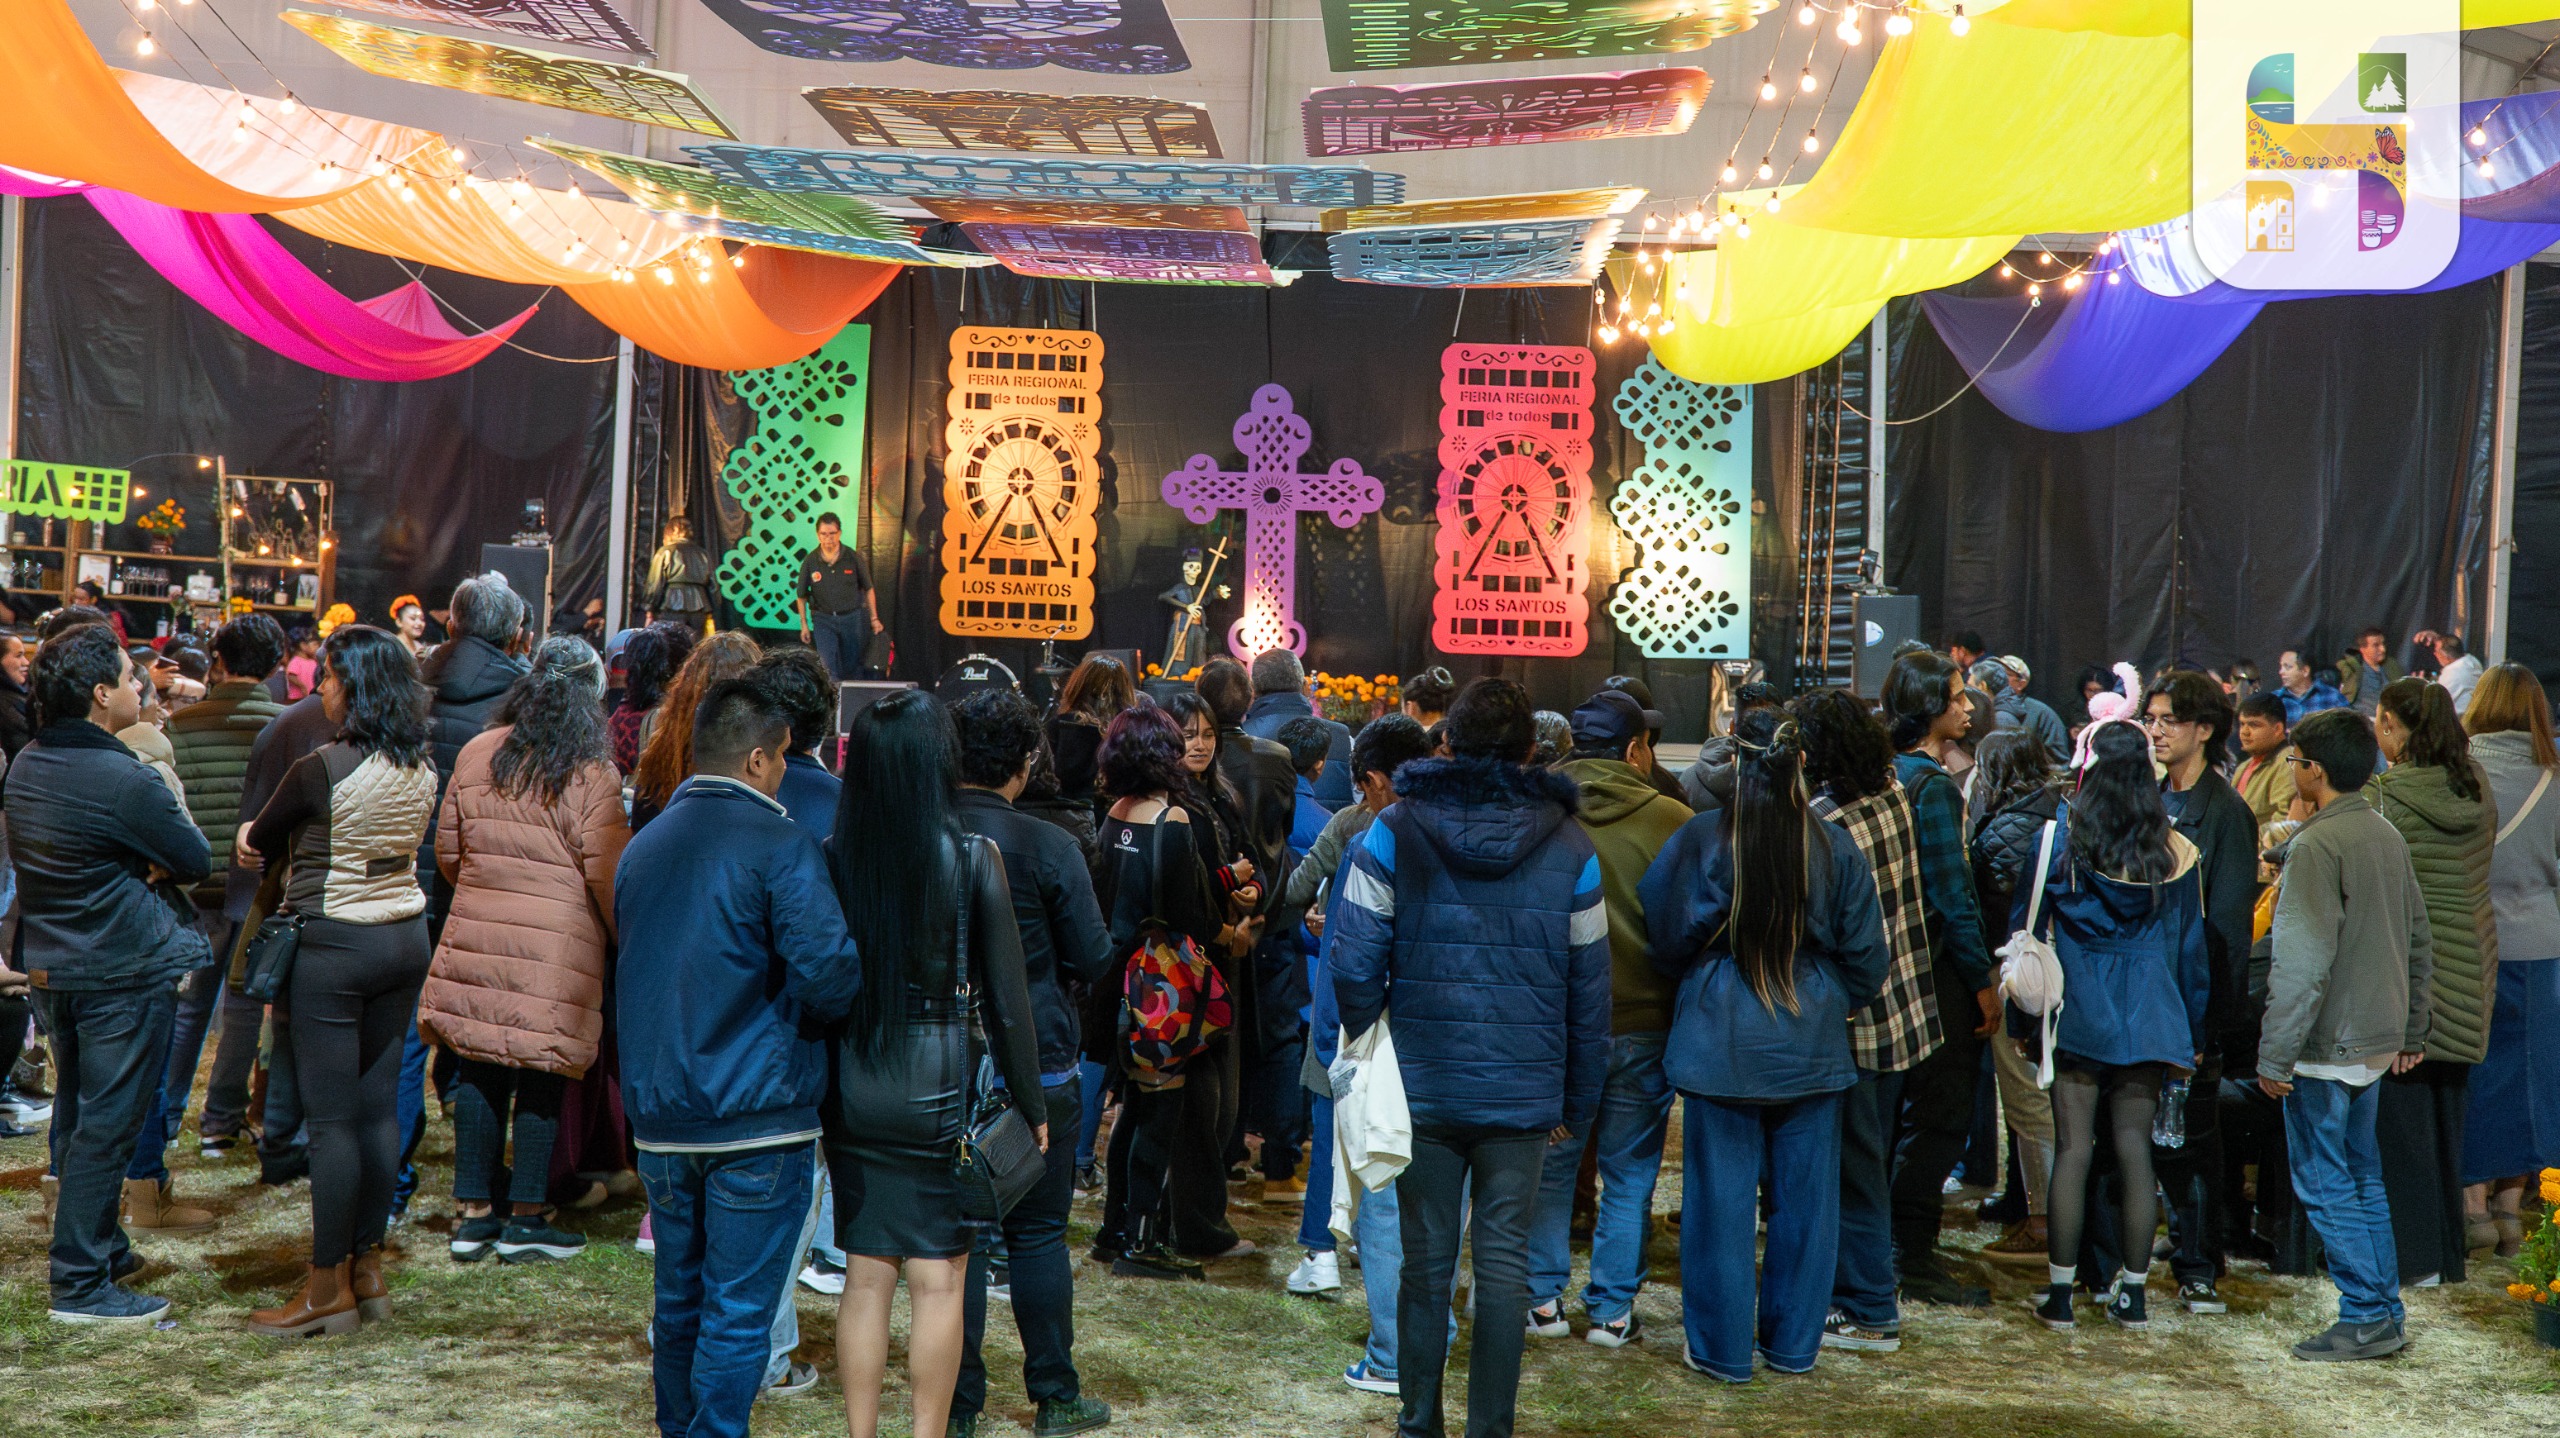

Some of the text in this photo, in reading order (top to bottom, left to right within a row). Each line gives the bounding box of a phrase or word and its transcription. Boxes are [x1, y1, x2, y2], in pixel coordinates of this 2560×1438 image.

[968, 373, 1087, 390] FERIA REGIONAL
[993, 393, 1057, 406] de todos
[1460, 391, 1580, 405] FERIA REGIONAL
[1486, 410, 1550, 422] de todos
[962, 580, 1072, 597] LOS SANTOS
[1455, 597, 1567, 614] LOS SANTOS
